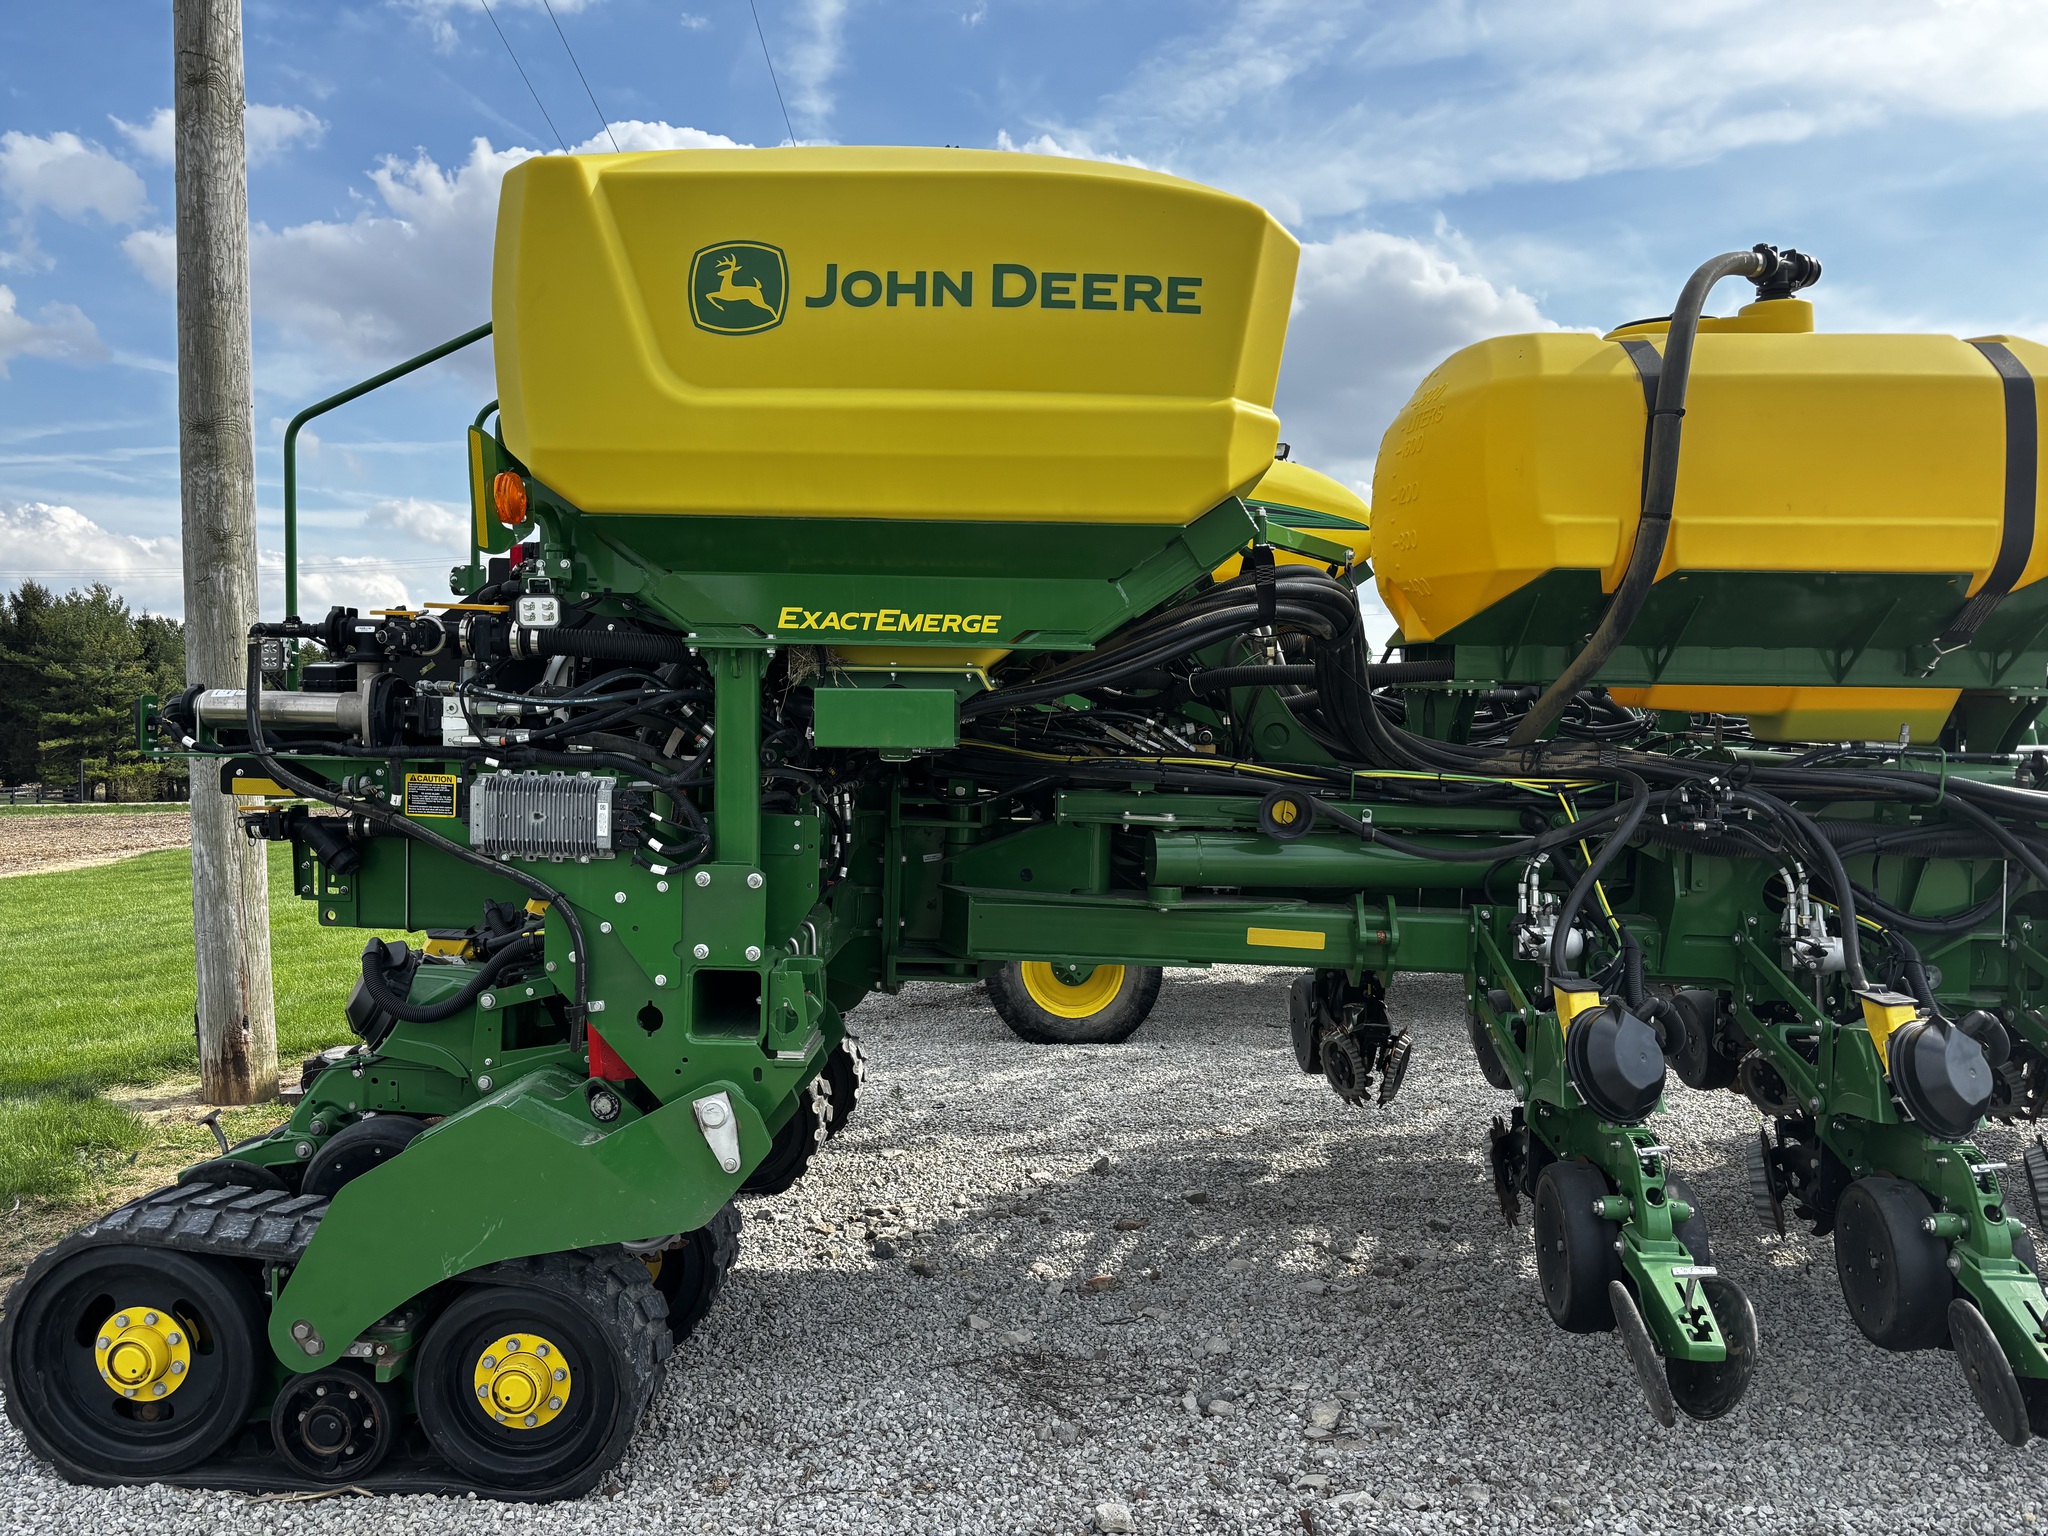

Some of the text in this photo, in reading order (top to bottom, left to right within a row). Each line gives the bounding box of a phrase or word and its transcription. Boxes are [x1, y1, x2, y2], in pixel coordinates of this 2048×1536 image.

[805, 263, 1203, 315] JOHN DEERE
[1405, 403, 1446, 434] LITERS
[416, 775, 453, 783] CAUTION
